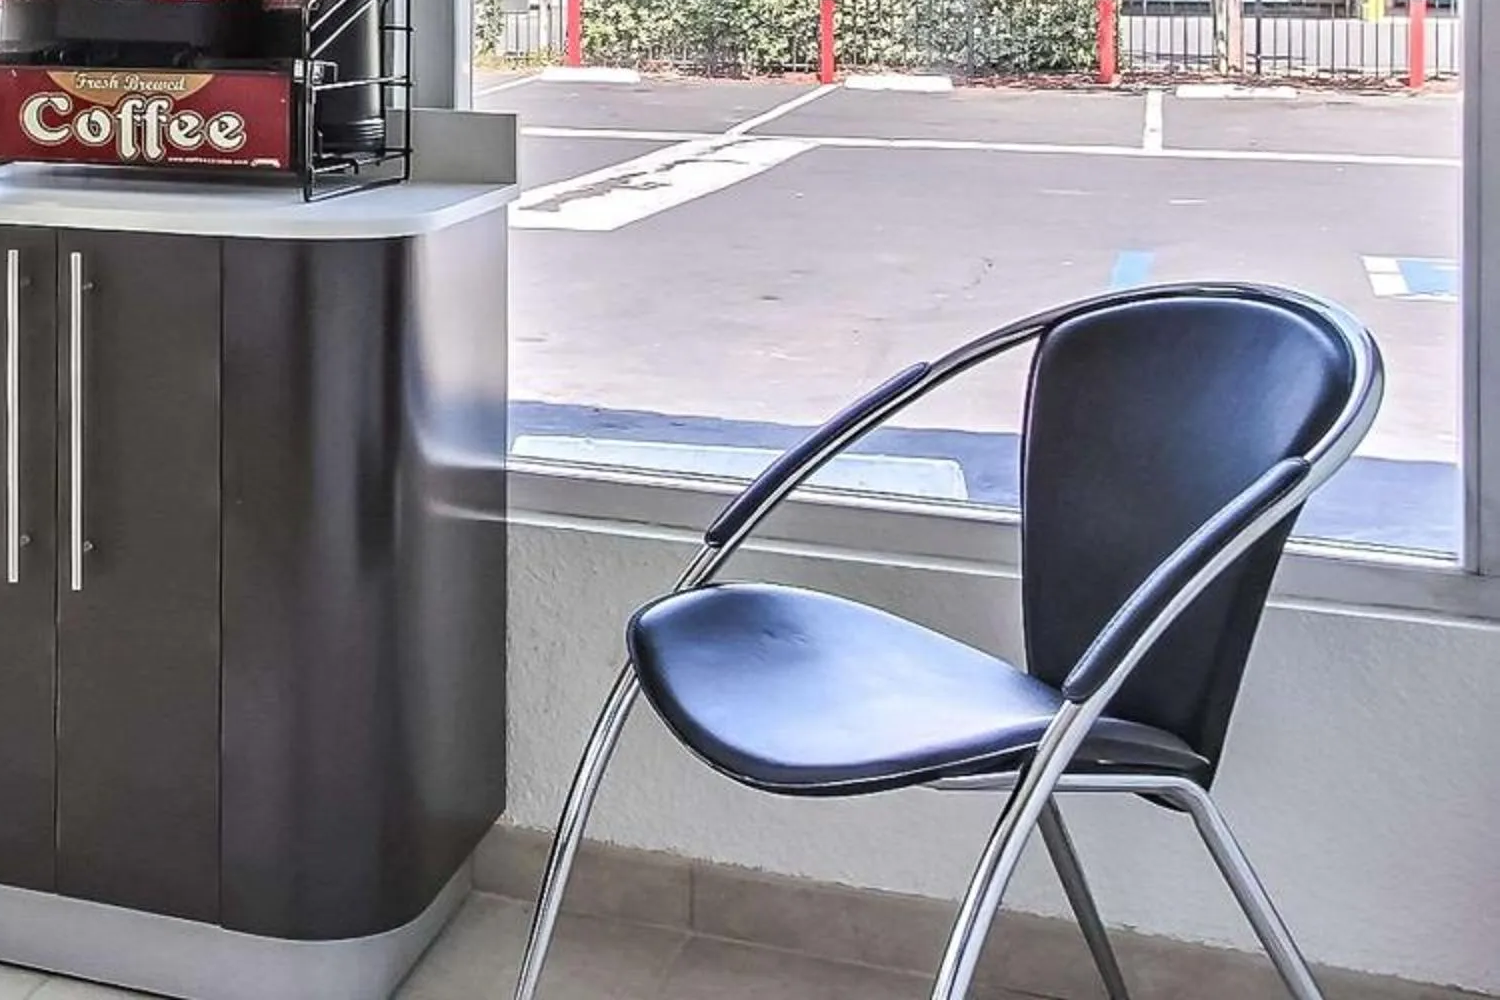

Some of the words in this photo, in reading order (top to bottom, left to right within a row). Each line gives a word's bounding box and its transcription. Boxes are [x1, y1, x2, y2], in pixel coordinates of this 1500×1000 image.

[76, 73, 119, 90] Fresh
[123, 73, 187, 91] Brewed
[20, 93, 246, 161] Coffee
